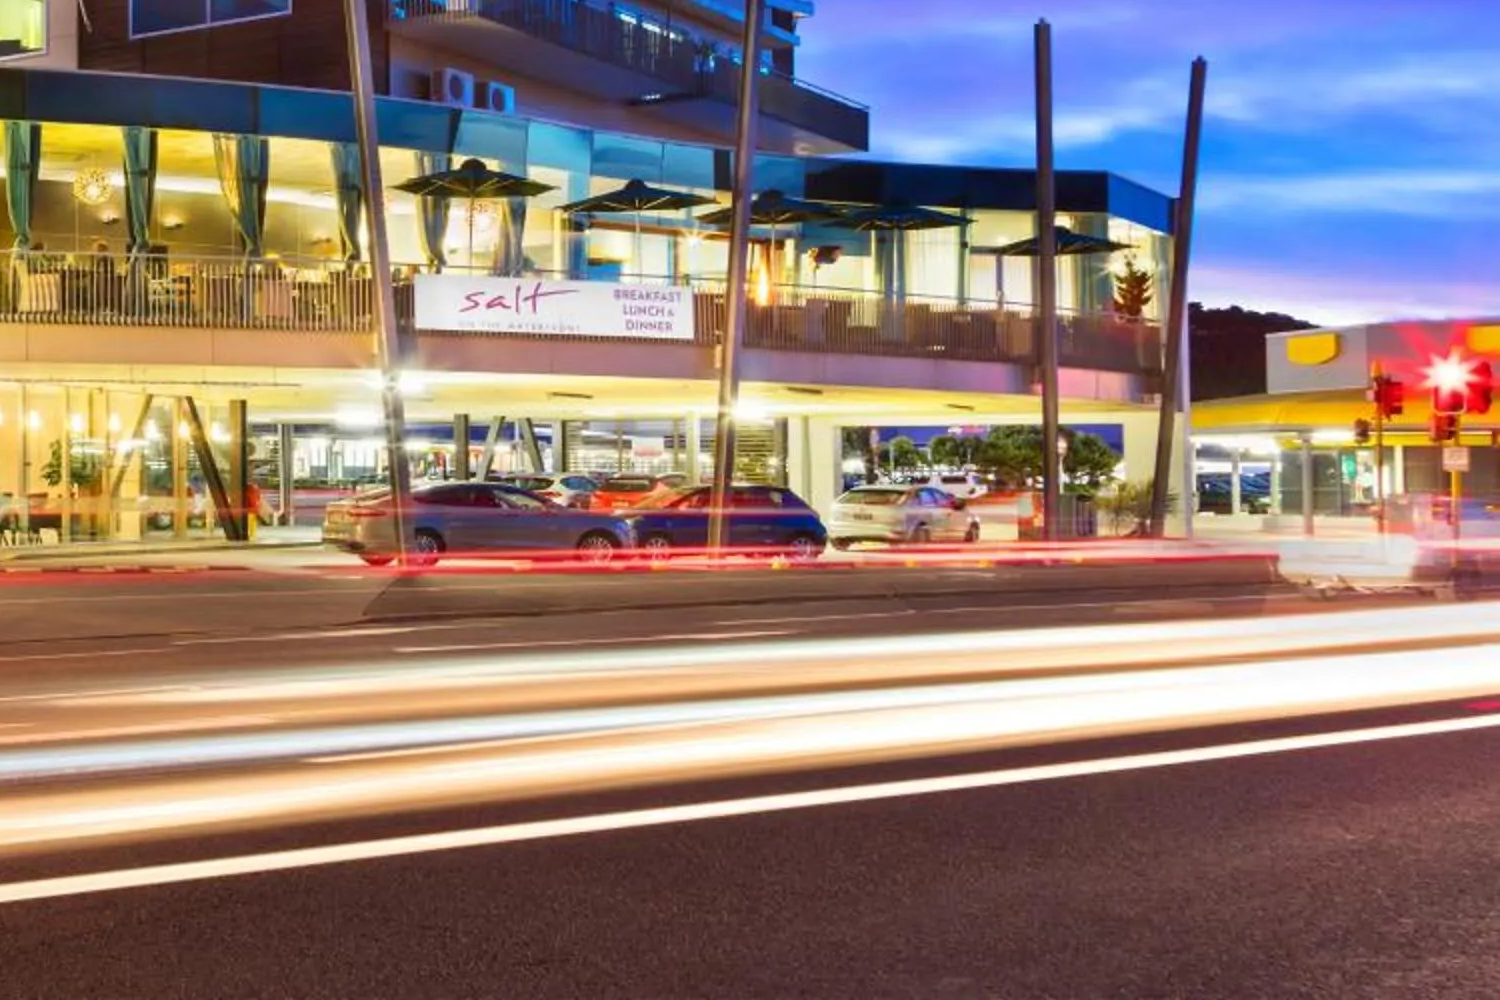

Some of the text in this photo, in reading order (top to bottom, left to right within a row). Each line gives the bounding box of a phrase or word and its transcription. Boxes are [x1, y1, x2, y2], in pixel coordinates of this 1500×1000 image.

[459, 282, 581, 315] salt
[613, 288, 682, 303] BREAKFAST
[622, 304, 665, 317] LUNCH
[625, 319, 674, 332] DINNER
